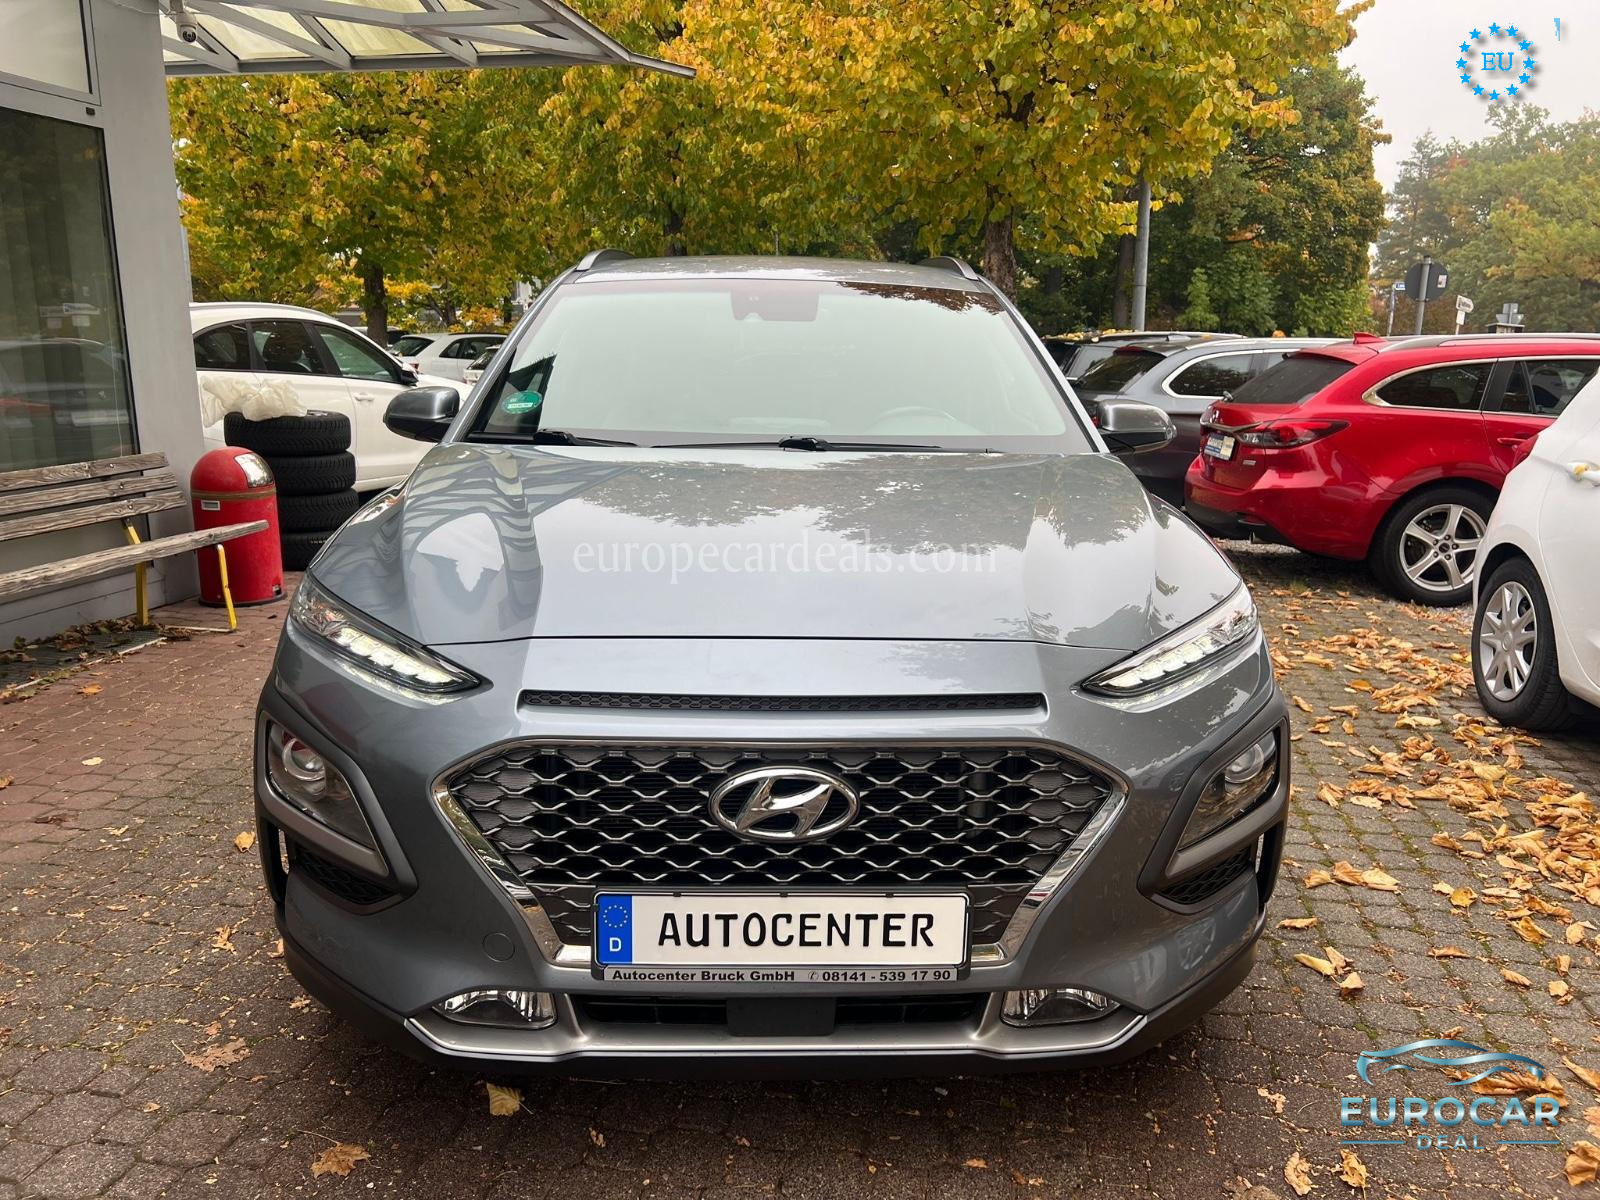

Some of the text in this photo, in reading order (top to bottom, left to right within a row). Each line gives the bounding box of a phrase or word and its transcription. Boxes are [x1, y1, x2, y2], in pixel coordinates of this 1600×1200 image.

[657, 912, 935, 948] AUTOCENTER
[609, 937, 622, 953] D
[612, 969, 697, 981] Autocenter
[701, 970, 745, 981] Bruck
[749, 970, 796, 981] GmbH
[822, 970, 867, 982] 08141
[879, 970, 906, 982] 539
[911, 970, 929, 981] 17
[932, 970, 951, 981] 90
